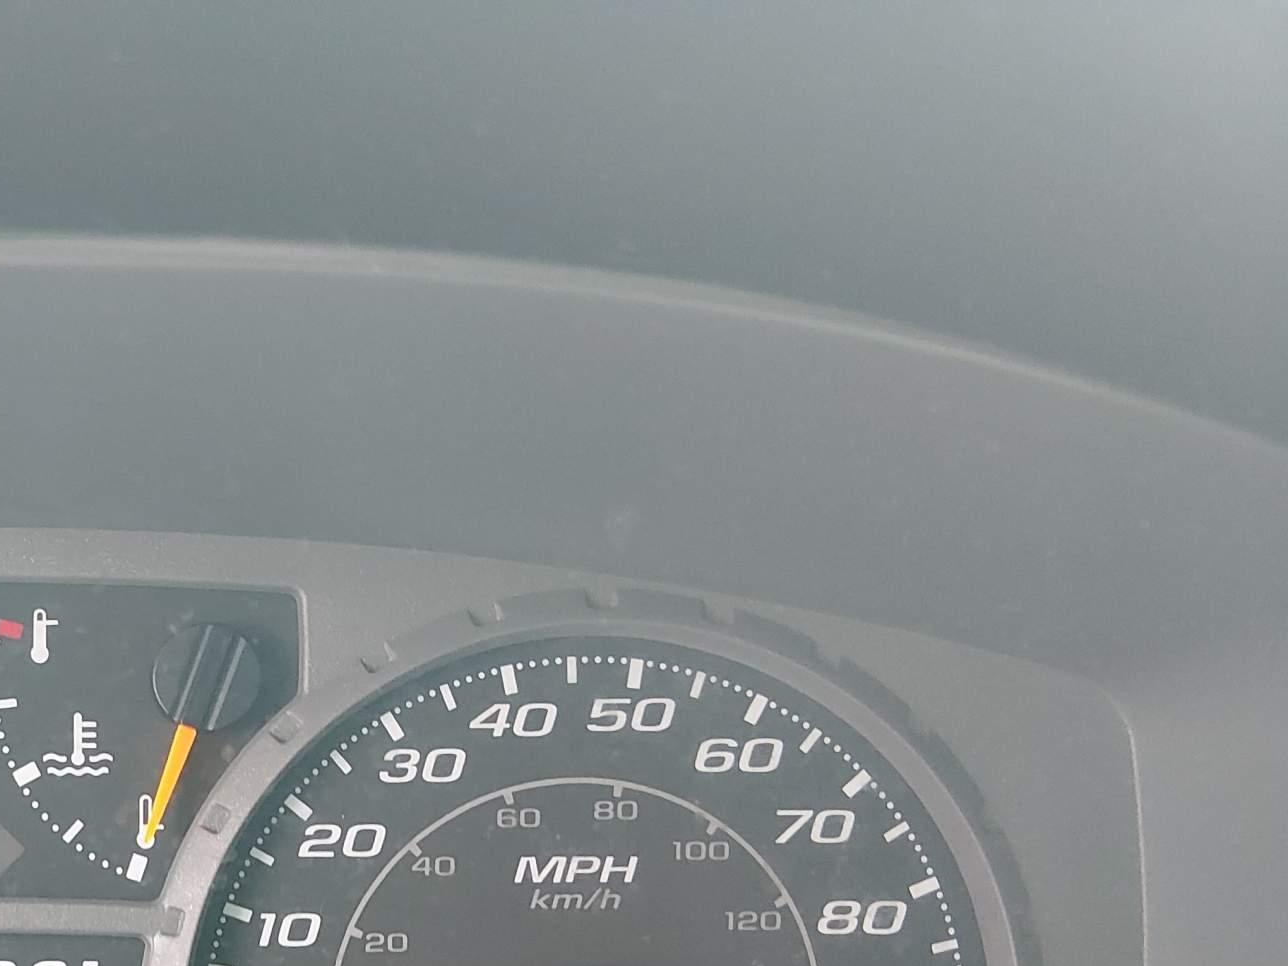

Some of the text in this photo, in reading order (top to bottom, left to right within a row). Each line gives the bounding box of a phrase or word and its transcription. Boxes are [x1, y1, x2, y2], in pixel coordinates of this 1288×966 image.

[469, 703, 558, 737] 40
[587, 697, 676, 732] 50
[379, 748, 466, 783] 30
[694, 738, 784, 773] 60
[496, 808, 541, 828] 60
[593, 800, 638, 820] 80
[298, 823, 386, 858] 20
[775, 809, 855, 844] 70
[411, 856, 456, 876] 40
[673, 841, 730, 861] 100
[514, 856, 638, 884] MPH
[530, 888, 621, 910] km/h
[259, 912, 321, 947] 10
[726, 911, 782, 931] 120
[817, 900, 907, 935] 80
[365, 933, 408, 953] 20
